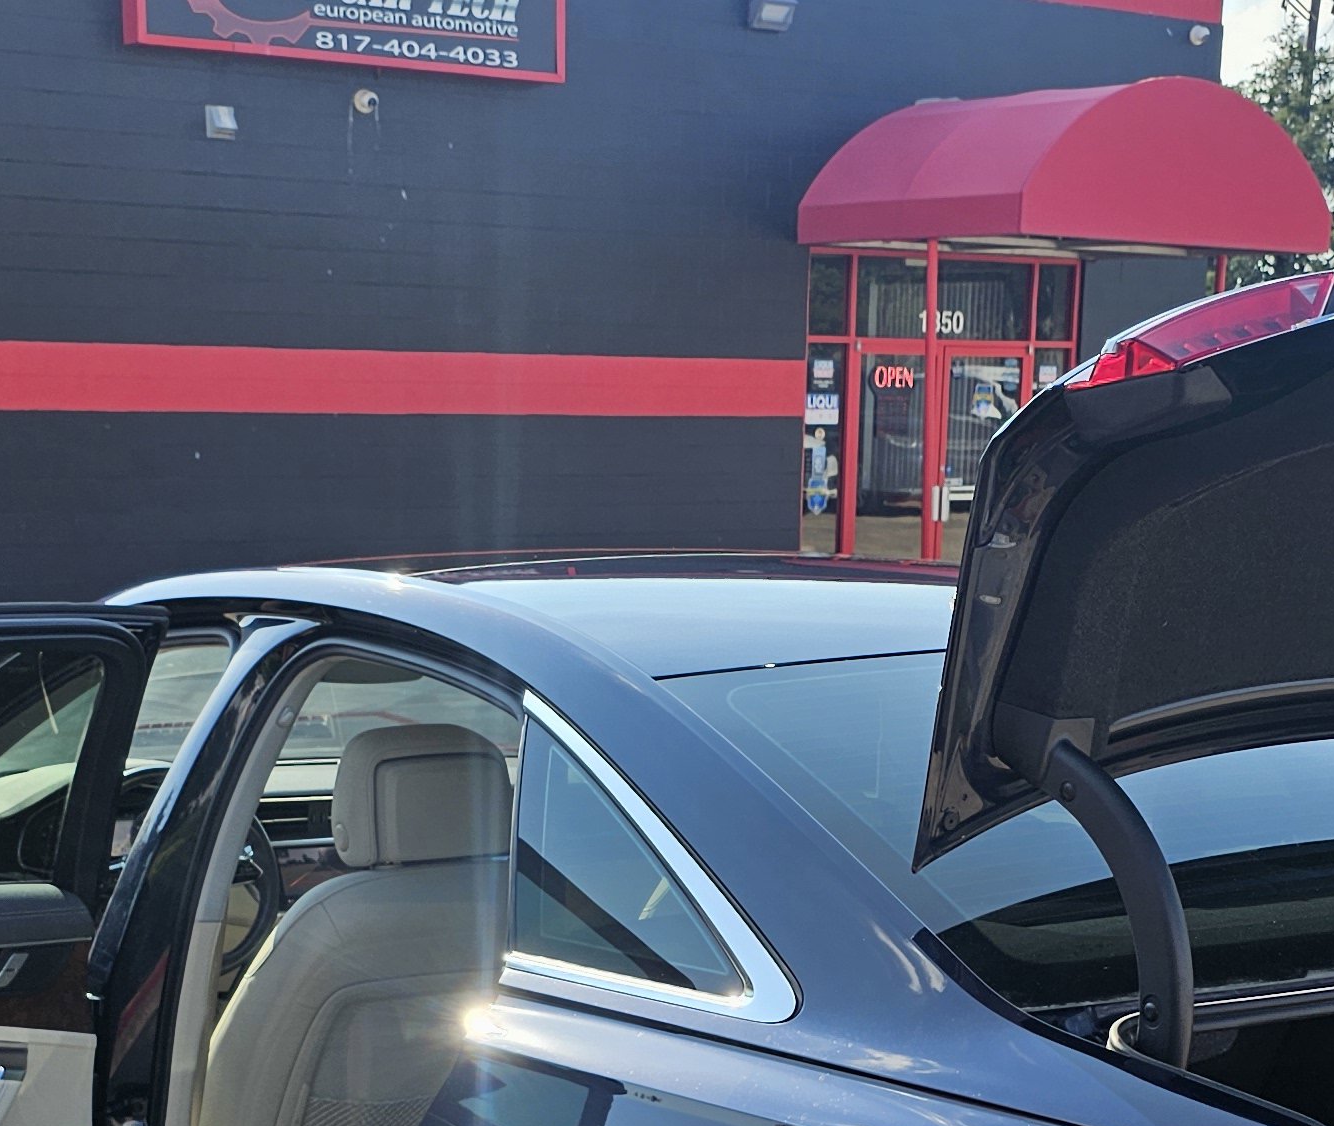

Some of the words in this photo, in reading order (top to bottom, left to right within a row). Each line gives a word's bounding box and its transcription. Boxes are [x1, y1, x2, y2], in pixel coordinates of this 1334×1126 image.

[313, 3, 407, 24] european
[411, 13, 519, 37] automotive
[315, 31, 519, 68] 817-404-4033
[874, 365, 914, 389] OPEN
